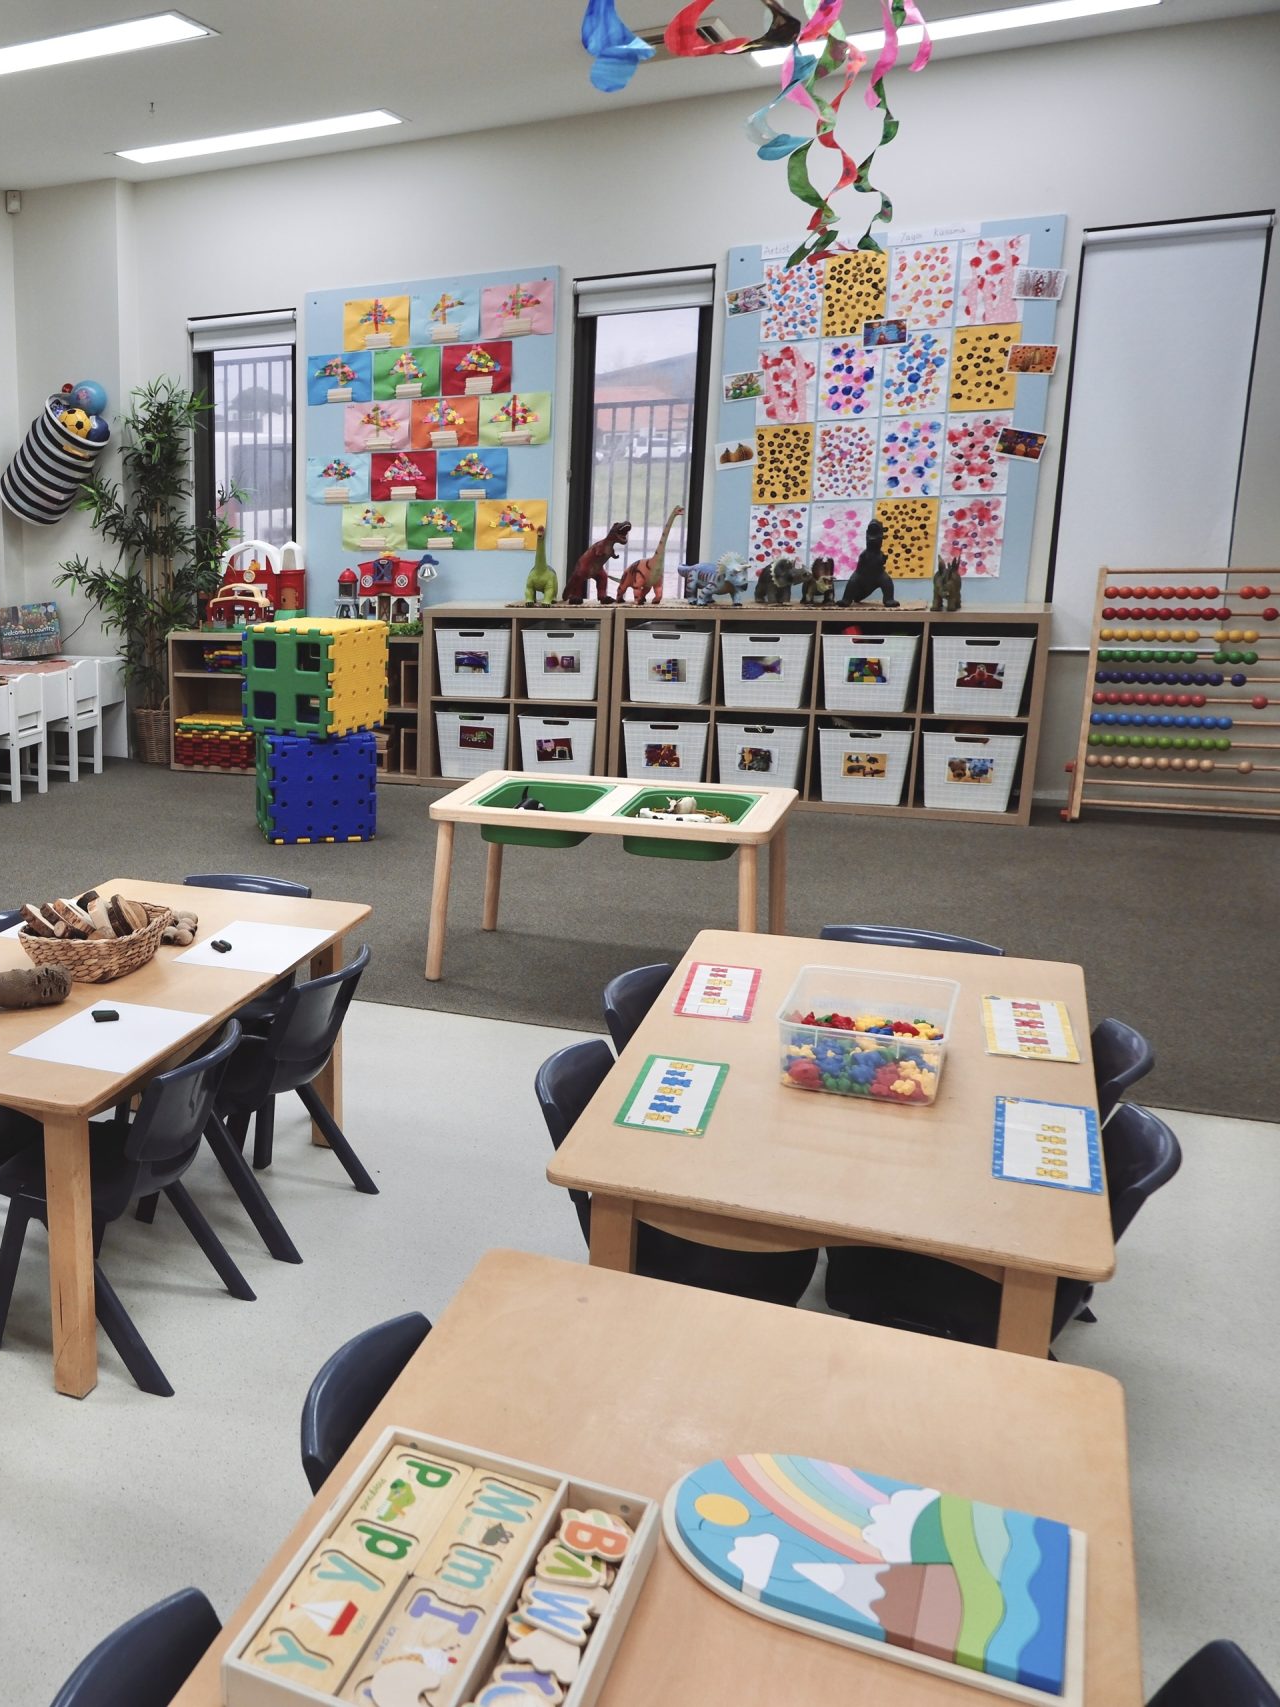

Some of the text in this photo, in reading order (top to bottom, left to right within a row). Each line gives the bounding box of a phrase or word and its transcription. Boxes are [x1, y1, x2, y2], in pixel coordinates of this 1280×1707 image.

[3, 629, 26, 637] welcome
[564, 1519, 630, 1557] B
[409, 1594, 479, 1635] I
[264, 1634, 327, 1671] Y
